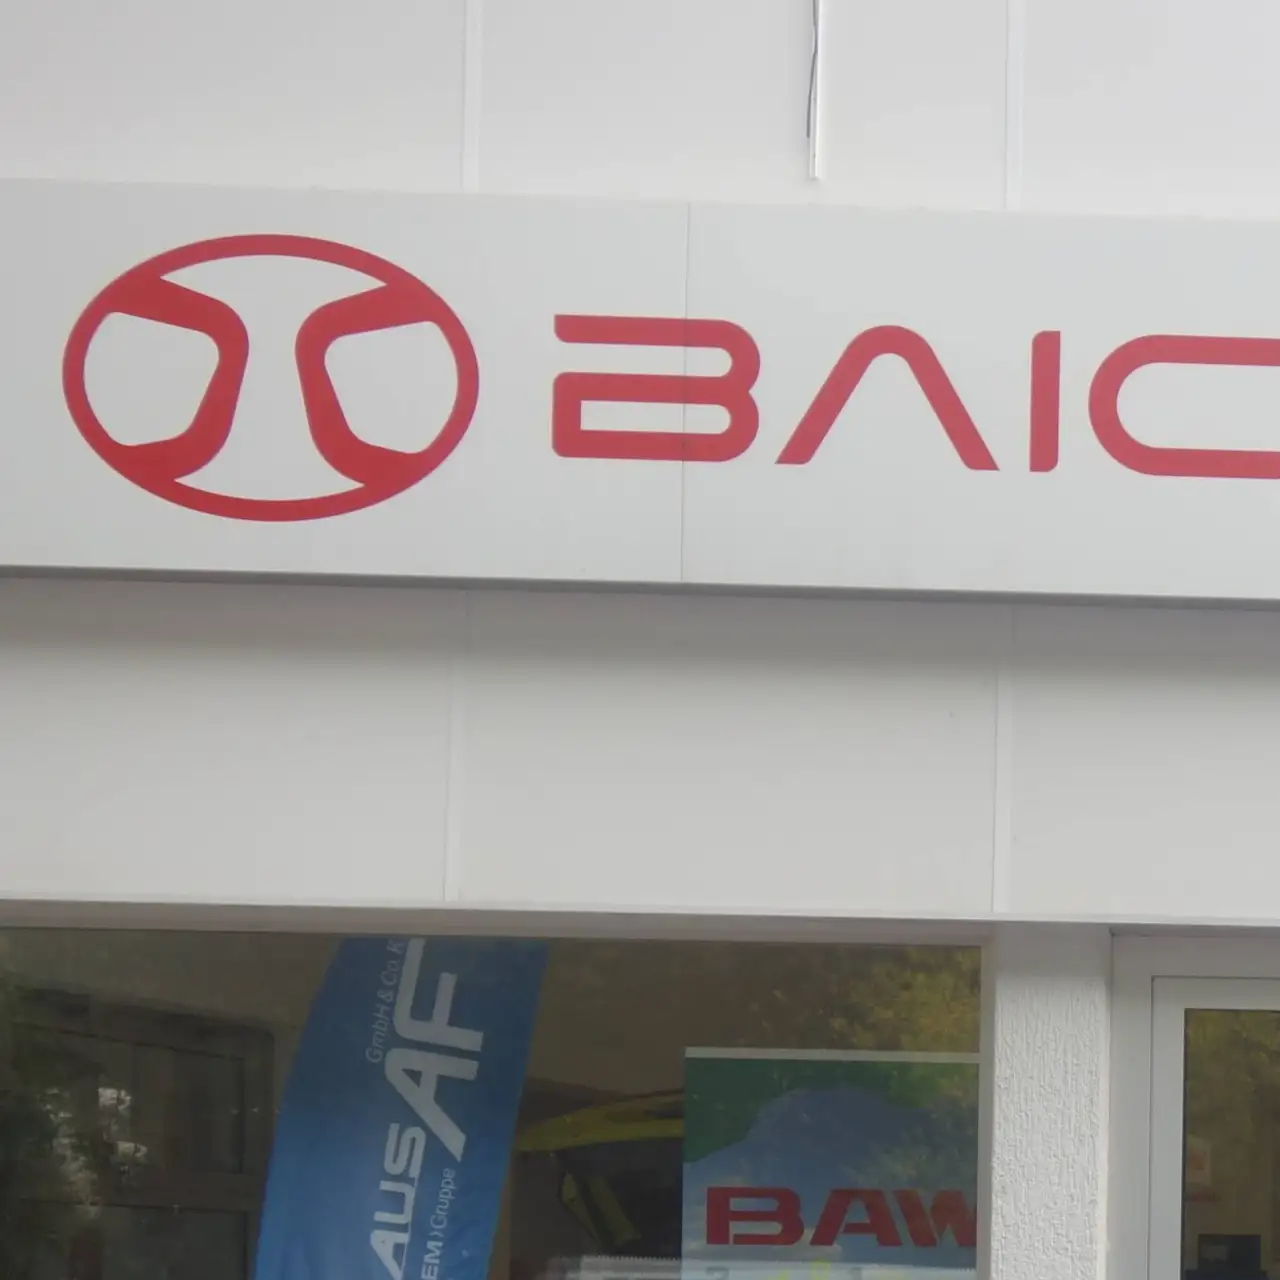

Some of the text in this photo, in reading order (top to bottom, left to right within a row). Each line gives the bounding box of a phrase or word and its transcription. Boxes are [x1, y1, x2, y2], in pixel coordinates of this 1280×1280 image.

[376, 988, 394, 1003] &
[366, 1004, 391, 1063] GmbH
[384, 937, 484, 1163] AF
[430, 1167, 457, 1229] Gruppe
[705, 1186, 978, 1247] BAW
